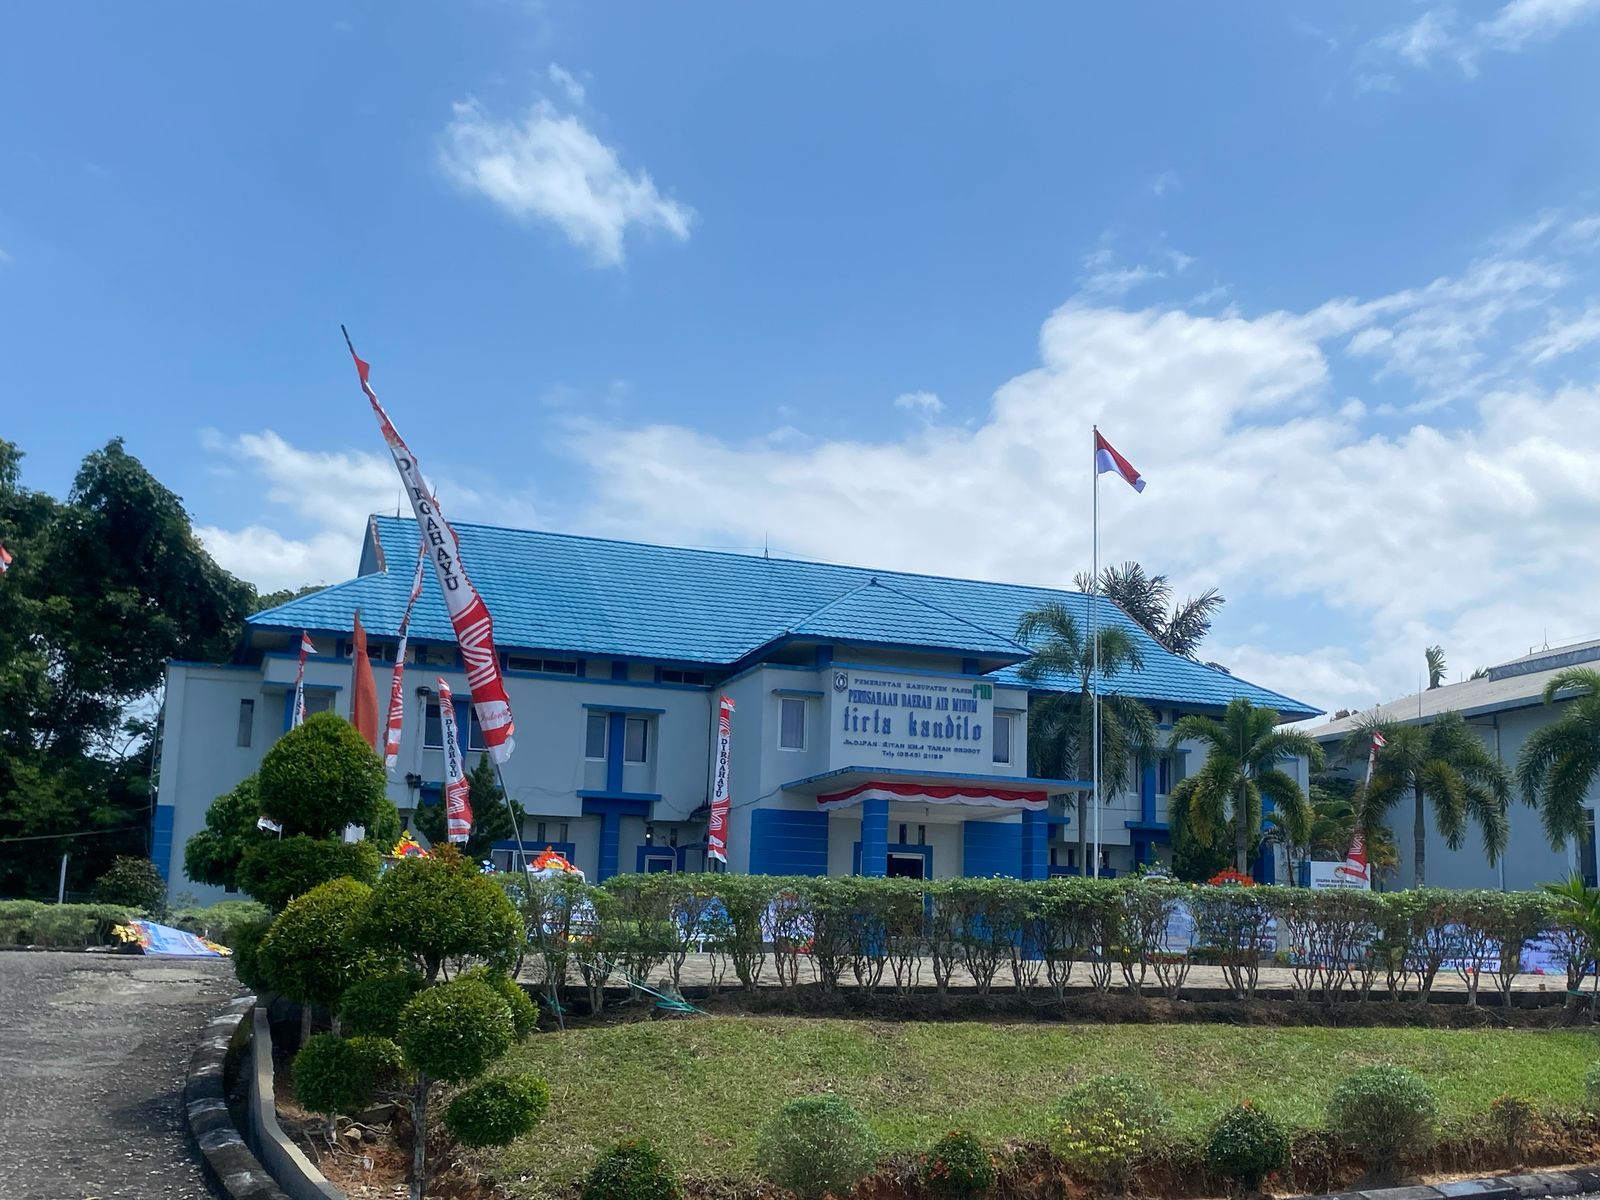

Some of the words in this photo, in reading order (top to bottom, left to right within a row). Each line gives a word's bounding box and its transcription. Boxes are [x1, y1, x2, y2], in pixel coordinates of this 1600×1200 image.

[399, 458, 459, 591] DIRGAHAYU
[848, 689, 898, 707] PERUSAHAAN
[901, 693, 932, 710] DAERAH
[935, 696, 949, 711] AIR
[952, 697, 978, 713] MINUM
[854, 679, 902, 689] PEMERINTAH
[906, 683, 948, 692] KABUPATEN
[445, 718, 457, 778] DIRGAHAYU
[715, 738, 728, 798] DIRGAHAYU
